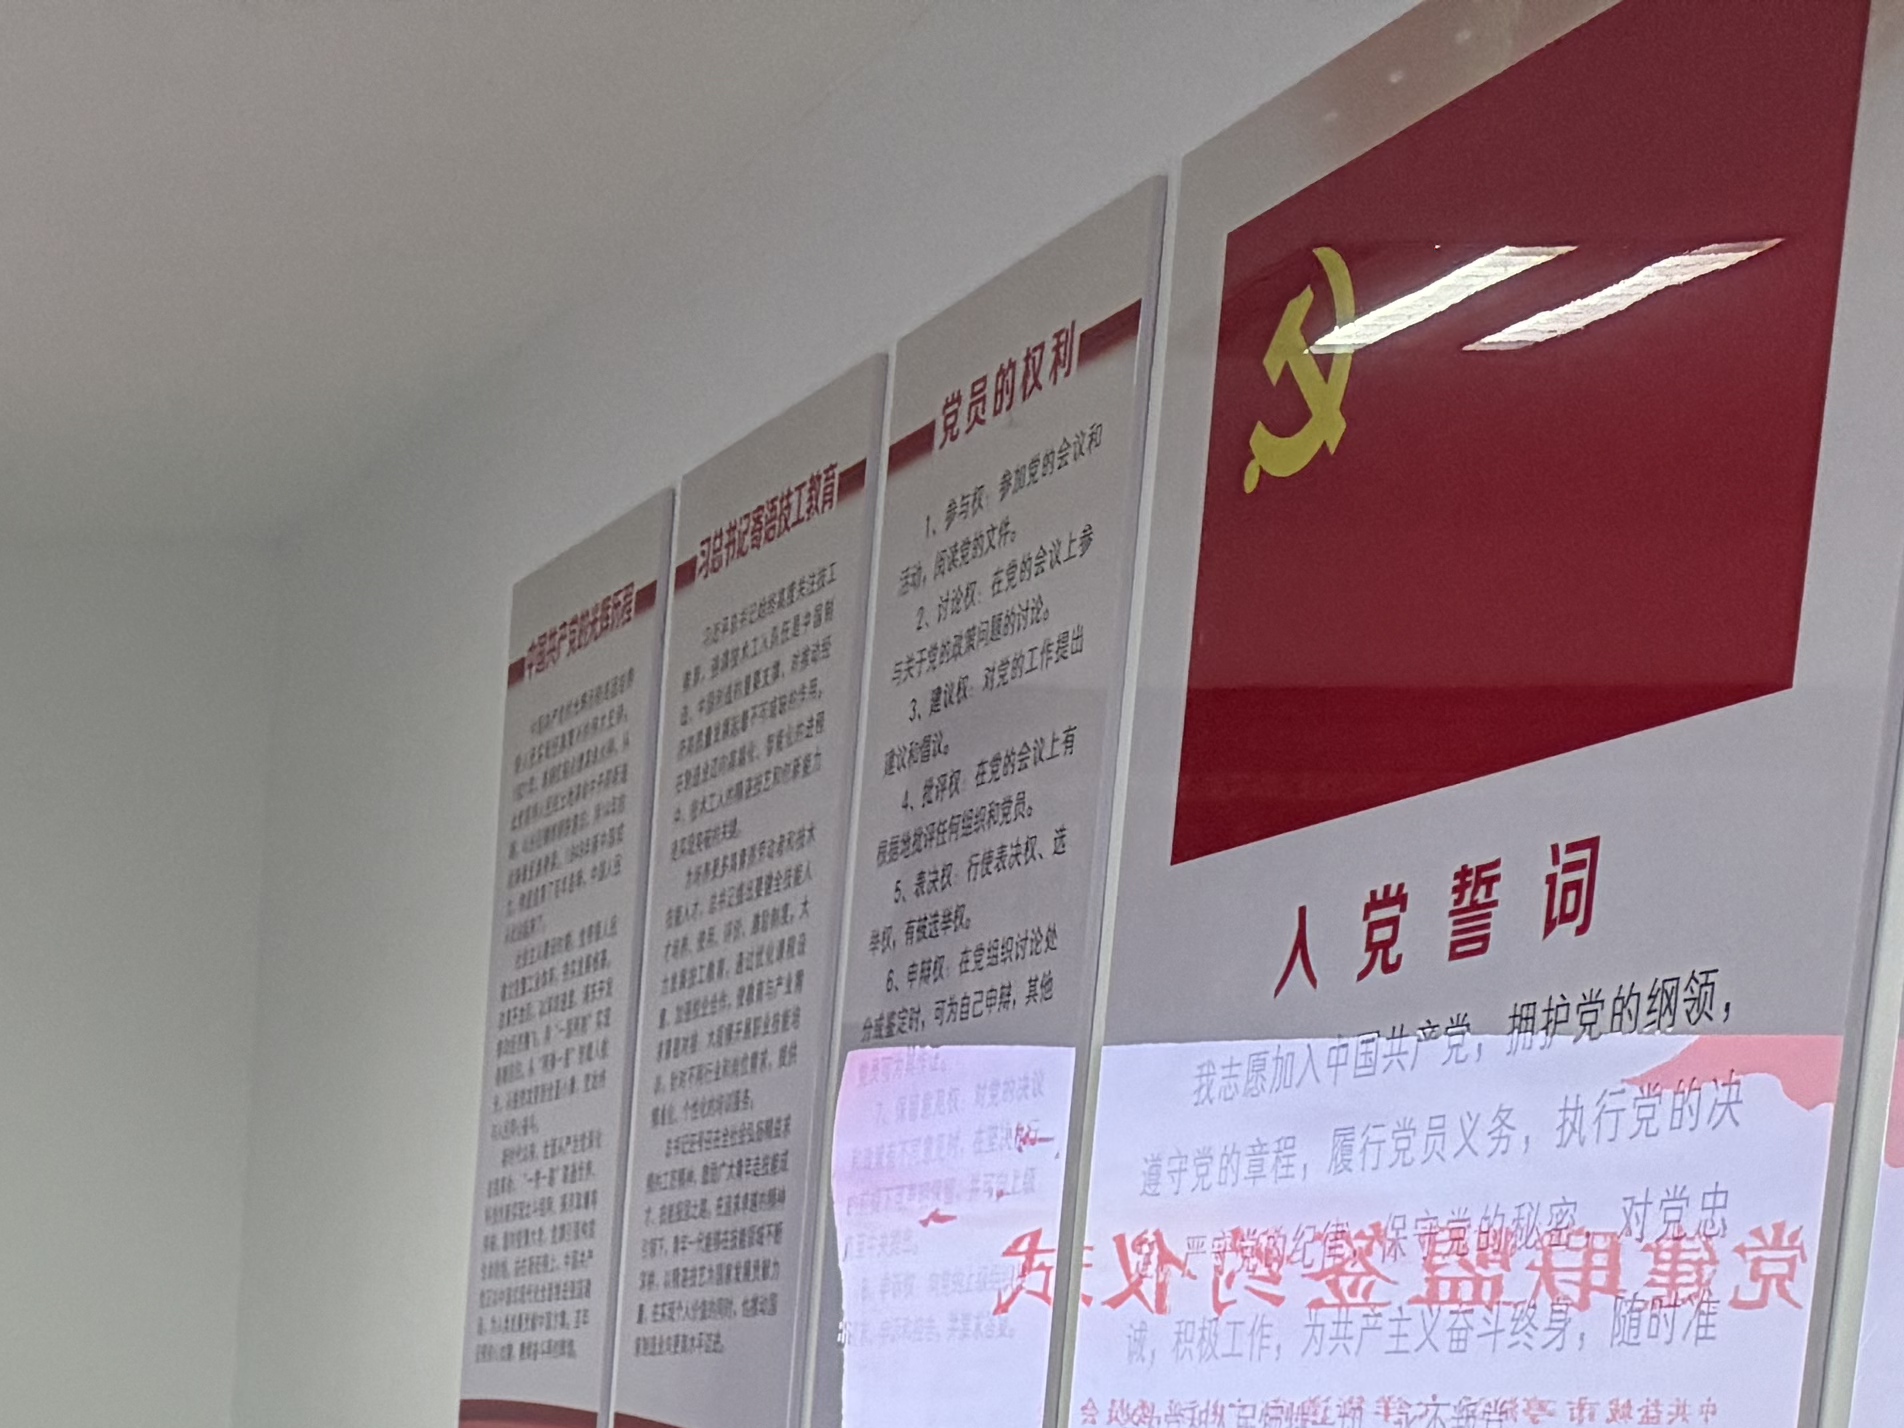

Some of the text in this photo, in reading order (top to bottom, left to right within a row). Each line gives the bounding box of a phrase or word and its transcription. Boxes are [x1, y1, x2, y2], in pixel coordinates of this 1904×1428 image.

[938, 319, 1078, 451] 党员的权利
[698, 463, 840, 581] 习总书记寄语技工教育
[1138, 1069, 1746, 1197] 遵守党的章程，履行党员义务，执行党的决
